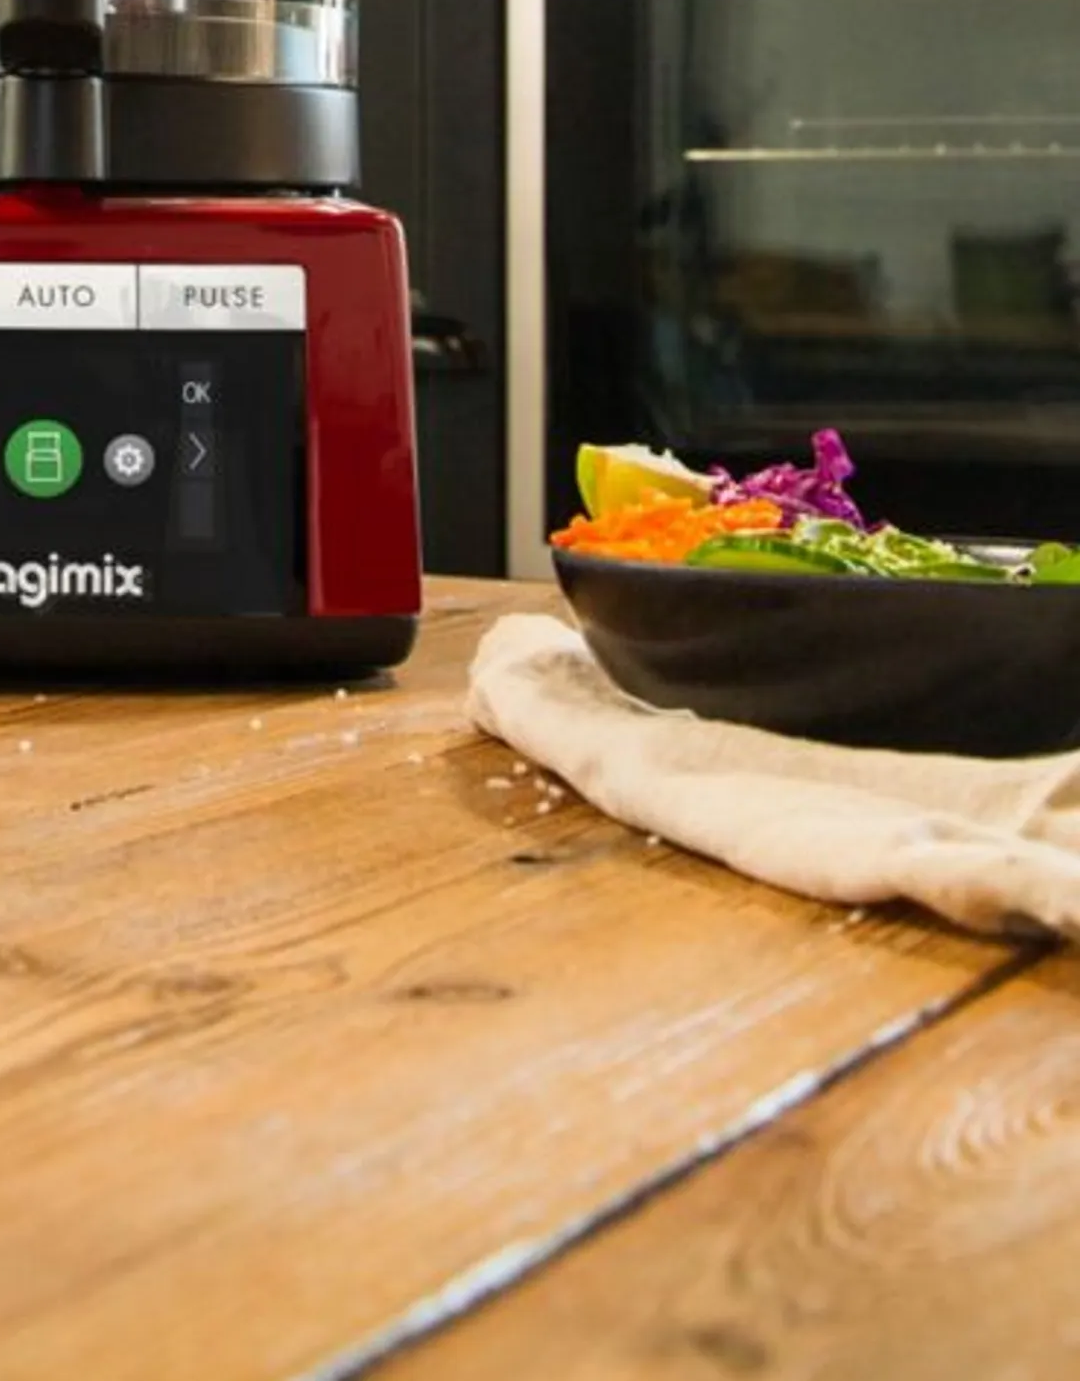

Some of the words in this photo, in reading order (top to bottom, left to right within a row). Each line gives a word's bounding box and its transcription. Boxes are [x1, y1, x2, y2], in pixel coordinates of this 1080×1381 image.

[18, 284, 96, 308] AUTO
[182, 284, 265, 308] PULSE
[181, 381, 211, 404] OK
